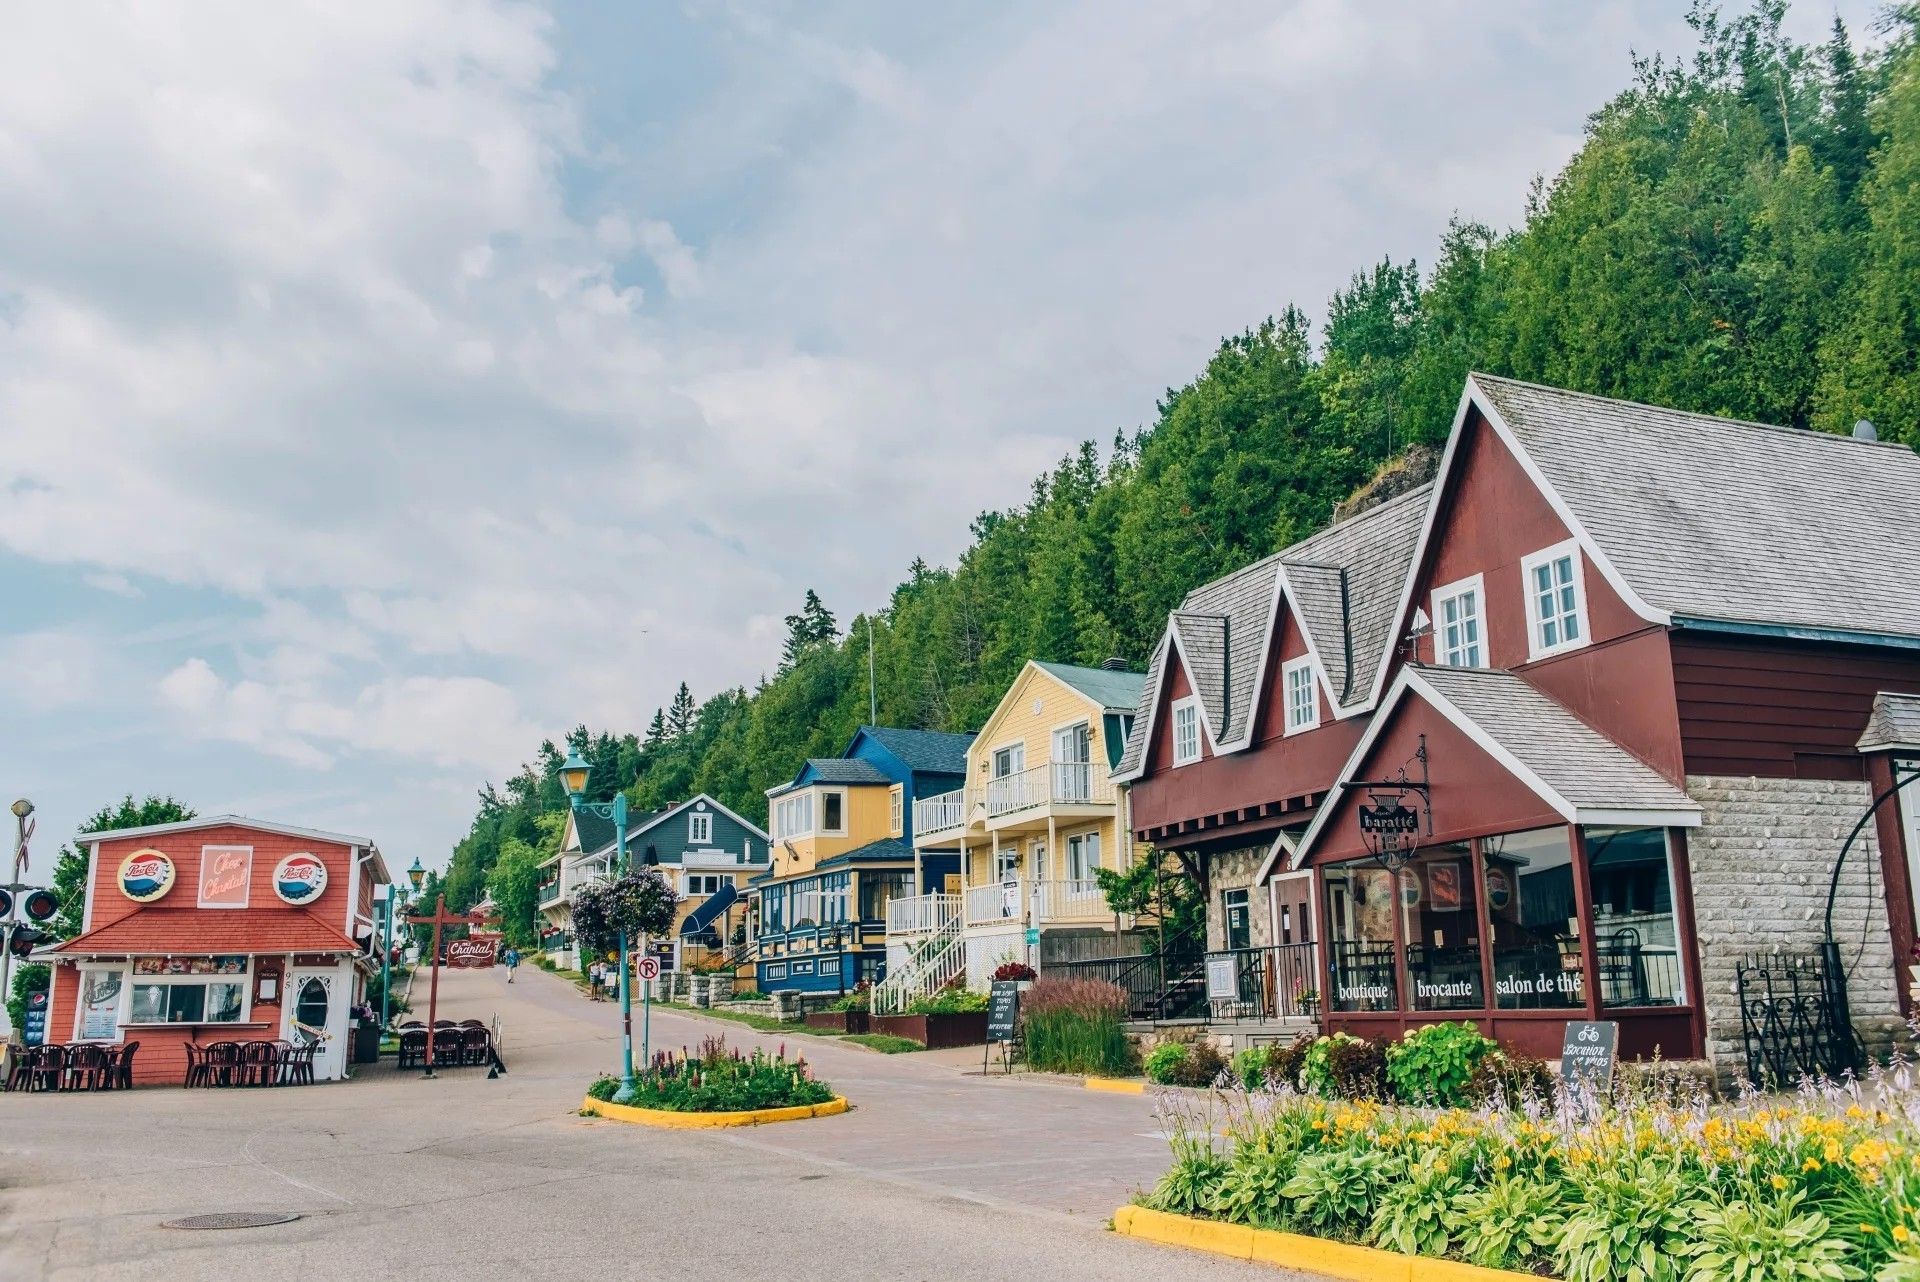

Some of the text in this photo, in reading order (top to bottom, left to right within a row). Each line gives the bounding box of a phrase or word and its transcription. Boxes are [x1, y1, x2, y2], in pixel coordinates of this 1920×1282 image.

[1364, 815, 1414, 828] baratté
[450, 941, 493, 956] Chantal
[1417, 979, 1472, 998] brocante
[1496, 971, 1582, 995] salon de thé
[1339, 982, 1389, 1004] boutique
